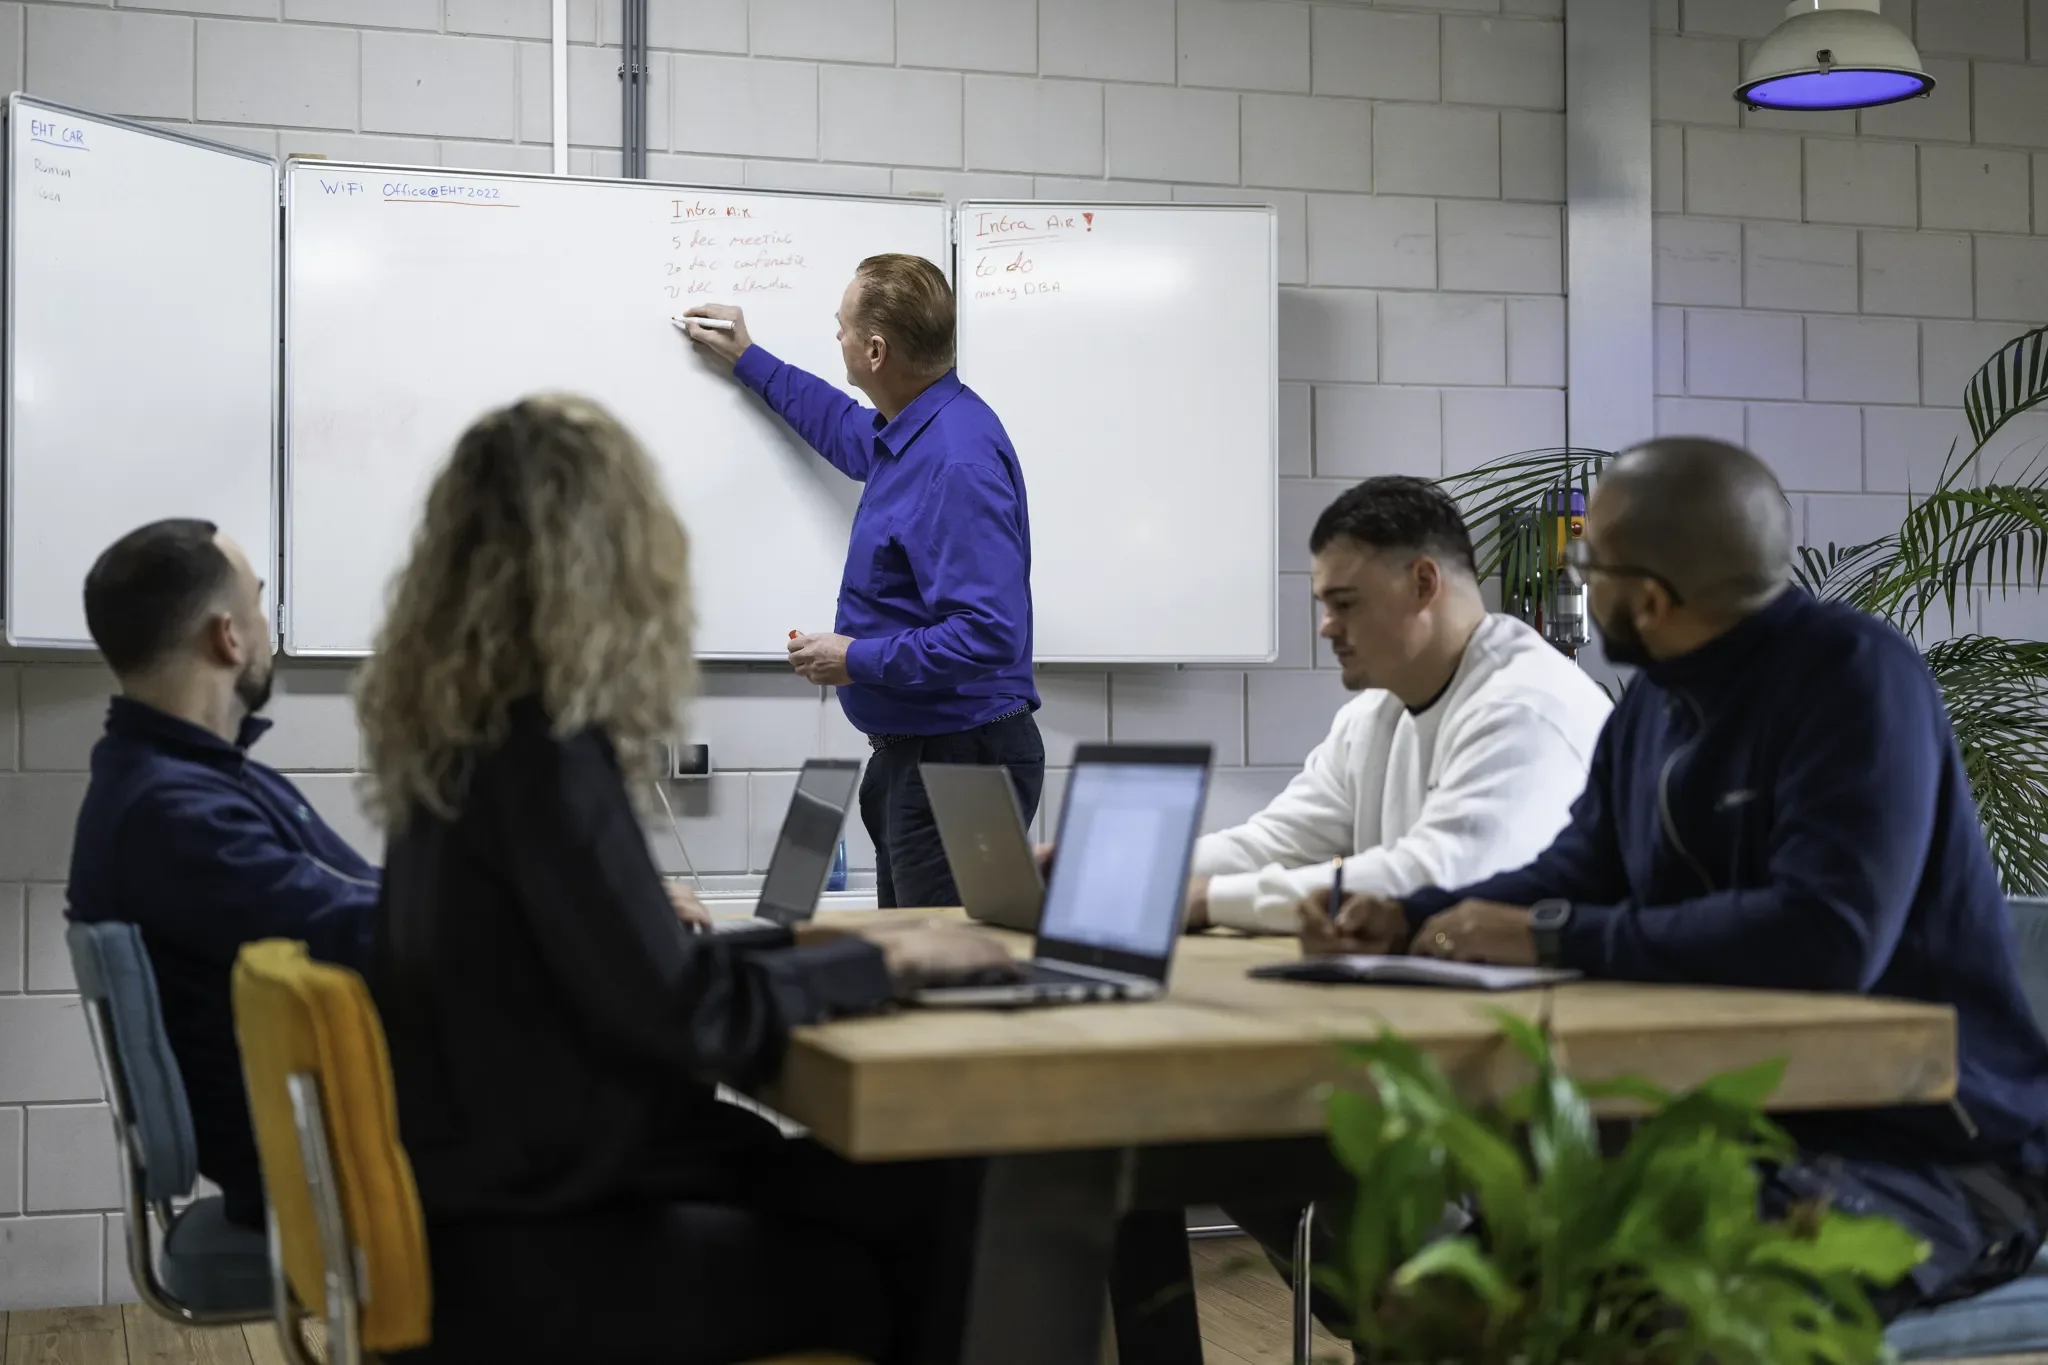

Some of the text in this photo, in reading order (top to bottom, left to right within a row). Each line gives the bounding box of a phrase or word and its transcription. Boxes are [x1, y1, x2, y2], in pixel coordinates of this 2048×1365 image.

[31, 119, 84, 145] EHT CAR
[320, 179, 364, 196] WiFi
[672, 200, 716, 218] Intra
[975, 212, 1036, 236] Intra
[976, 250, 1033, 277] to do
